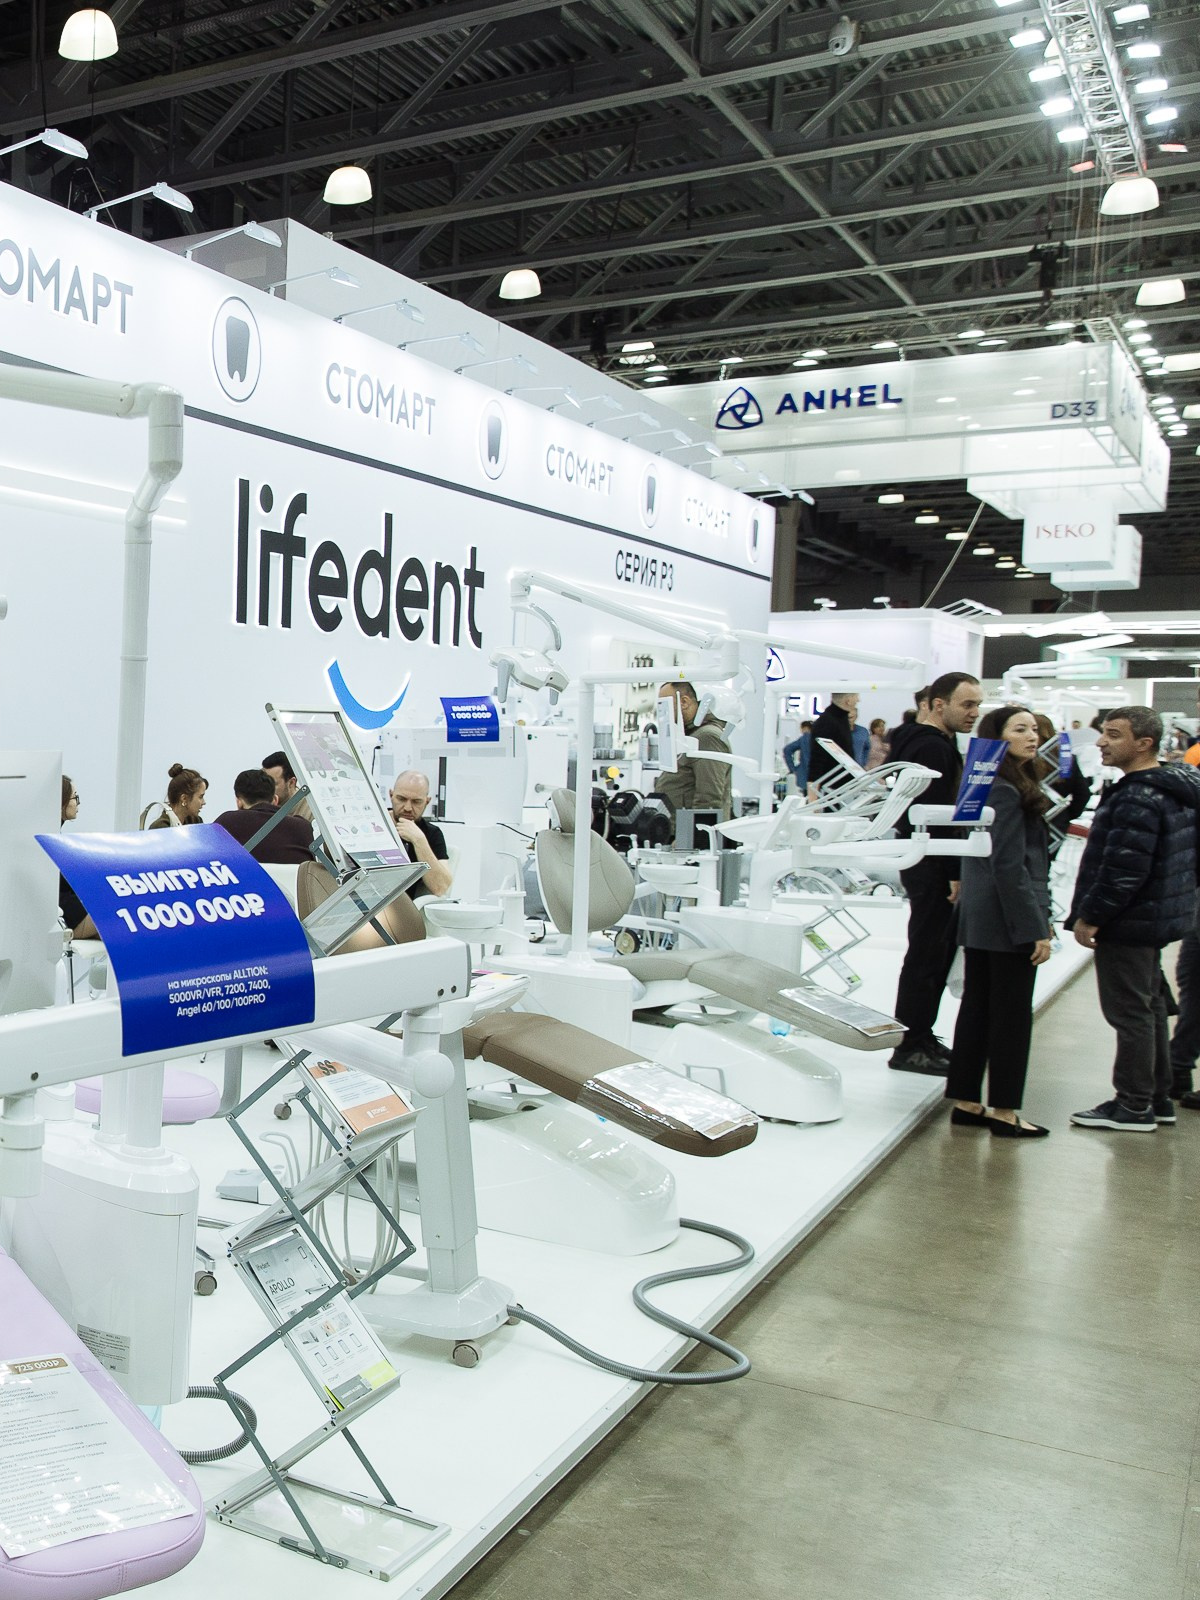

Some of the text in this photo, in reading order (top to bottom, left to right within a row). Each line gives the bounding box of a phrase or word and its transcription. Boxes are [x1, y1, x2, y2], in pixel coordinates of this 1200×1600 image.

[325, 362, 437, 436] СТОМАРТ
[775, 383, 903, 415] ANHEL
[1051, 400, 1098, 420] D33
[546, 444, 614, 496] СТОМАРТ
[1036, 523, 1095, 539] ISEKO
[236, 478, 485, 649] lifedent
[615, 549, 658, 588] СЕРИЯ
[105, 860, 240, 897] ВЫИГРАЙ
[116, 908, 138, 933] 1
[137, 901, 195, 930] 000
[168, 966, 269, 990] на микроскопы ALLTION:
[169, 979, 271, 1004] 5000VR/VFR, 7200, 7400,
[176, 993, 266, 1017] Angel 60/100/100PRO
[269, 1277, 295, 1295] APOLLO
[15, 1363, 34, 1373] 725
